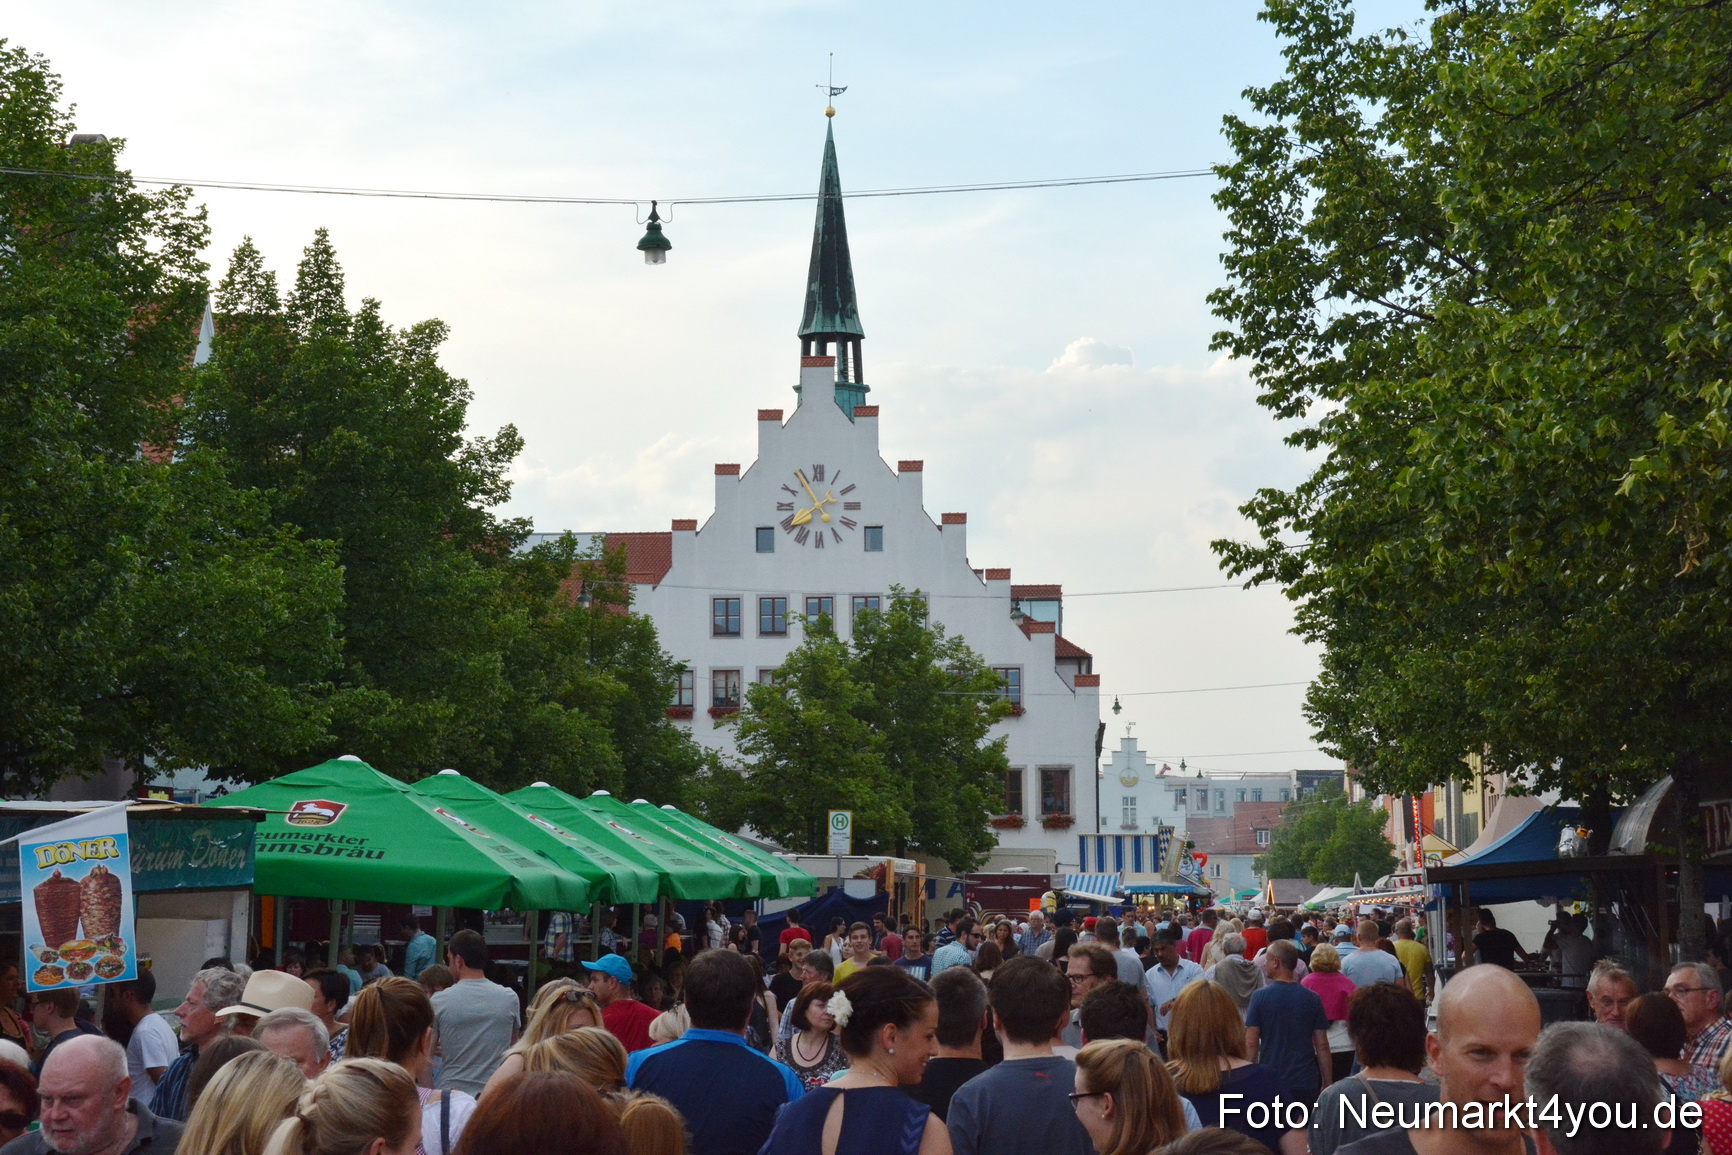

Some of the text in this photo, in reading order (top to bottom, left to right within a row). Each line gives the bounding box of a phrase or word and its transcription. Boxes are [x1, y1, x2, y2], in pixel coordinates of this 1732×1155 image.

[255, 831, 369, 846] eumarkter
[34, 837, 119, 870] DÖNER
[255, 842, 385, 860] msbräu
